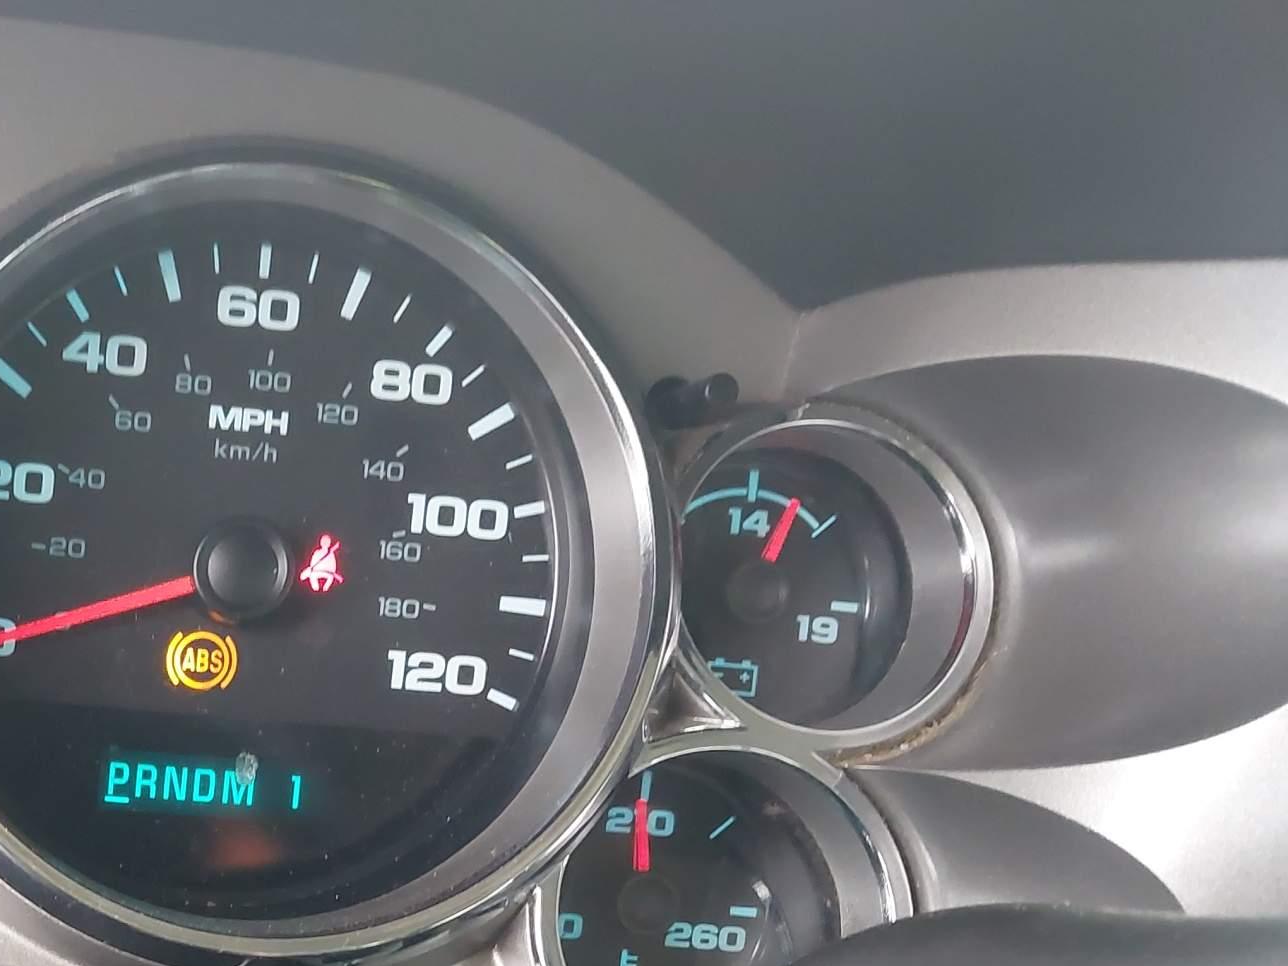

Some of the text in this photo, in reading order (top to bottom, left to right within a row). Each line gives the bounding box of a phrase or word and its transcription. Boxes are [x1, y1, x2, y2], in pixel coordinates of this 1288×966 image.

[217, 286, 300, 331] 60
[62, 332, 148, 377] 40
[174, 372, 212, 395] 80
[248, 368, 292, 393] 100
[370, 360, 453, 405] 80
[114, 409, 152, 433] 60
[208, 404, 288, 436] MPH
[316, 403, 359, 427] 120
[213, 438, 278, 464] km/h
[65, 467, 106, 490] 40
[362, 459, 405, 482] 140
[407, 493, 509, 540] 100
[728, 510, 770, 536] 14
[46, 537, 86, 559] 20
[378, 539, 422, 563] 160
[377, 597, 421, 620] 180
[796, 614, 839, 644] 19
[181, 647, 223, 673] ABS
[386, 649, 487, 696] 120
[290, 775, 302, 810] 1
[606, 809, 675, 837] 20
[665, 923, 746, 953] 260
